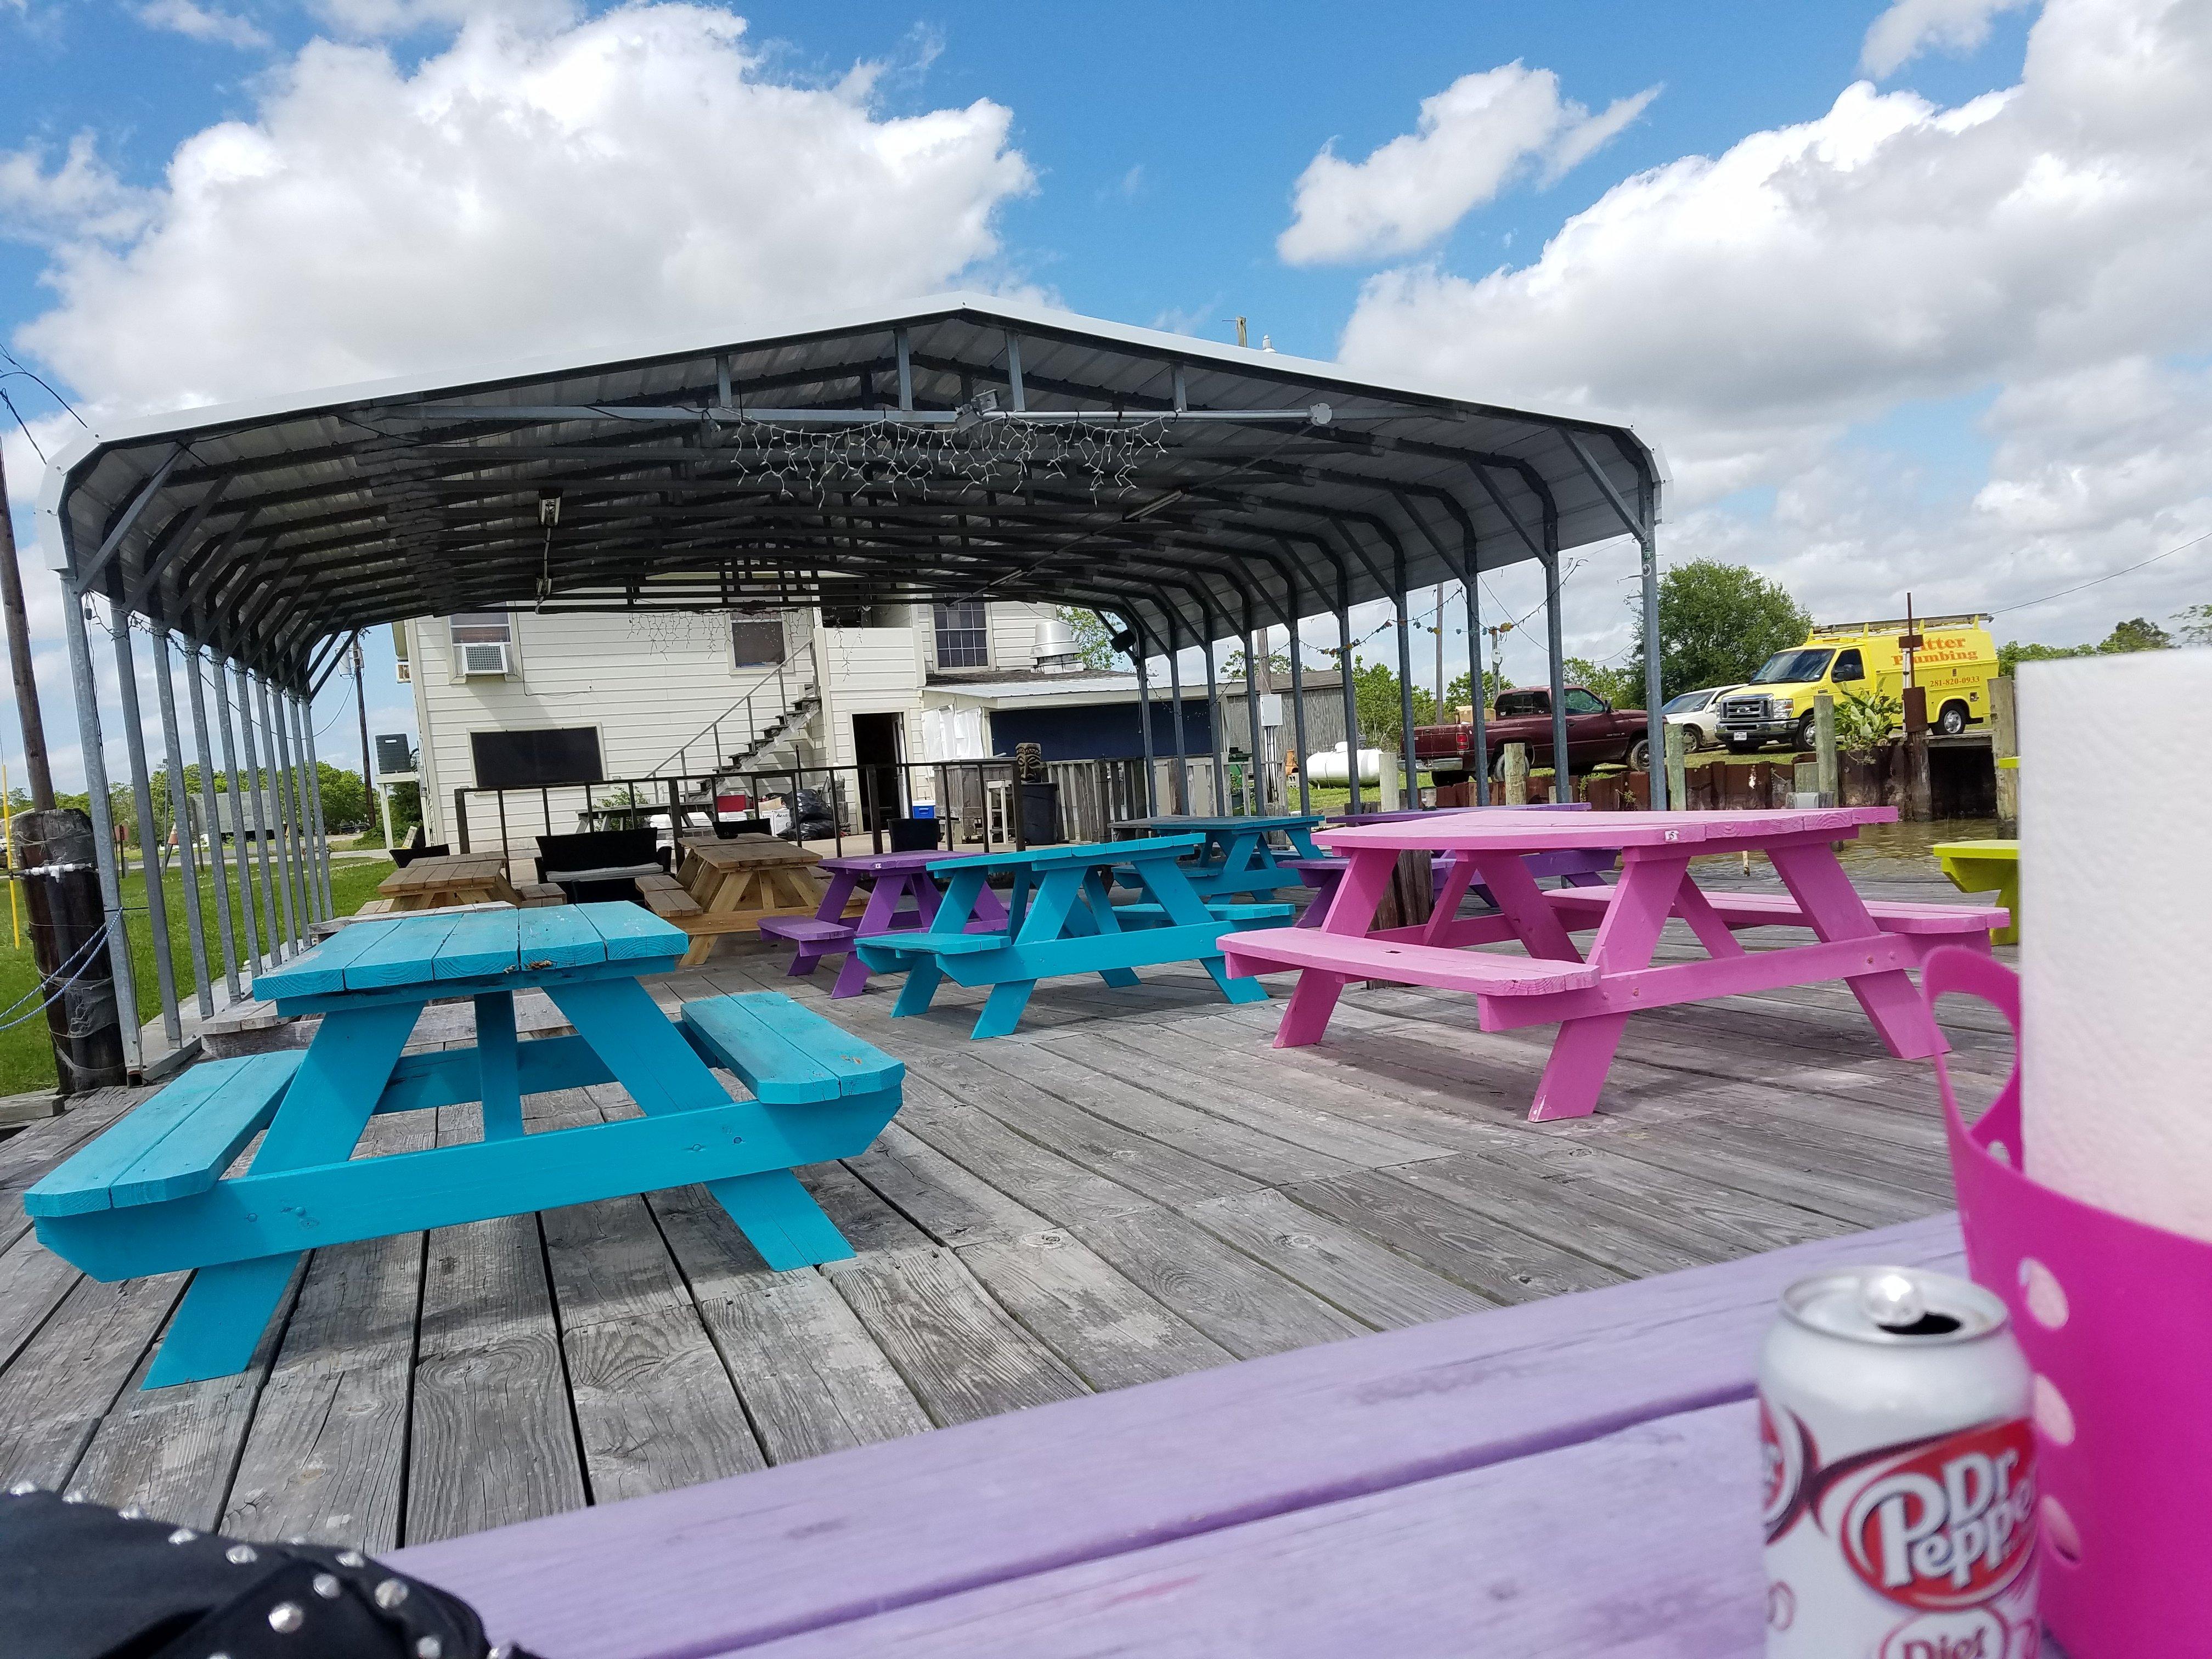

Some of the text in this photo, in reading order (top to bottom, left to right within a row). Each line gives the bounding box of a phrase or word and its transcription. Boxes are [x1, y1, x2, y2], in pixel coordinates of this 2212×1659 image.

[1891, 651, 1978, 666] Pumbing
[1929, 676, 1980, 687] 281-820-0933
[1942, 1448, 2019, 1524] Dr
[1848, 1471, 2032, 1589] Peppe
